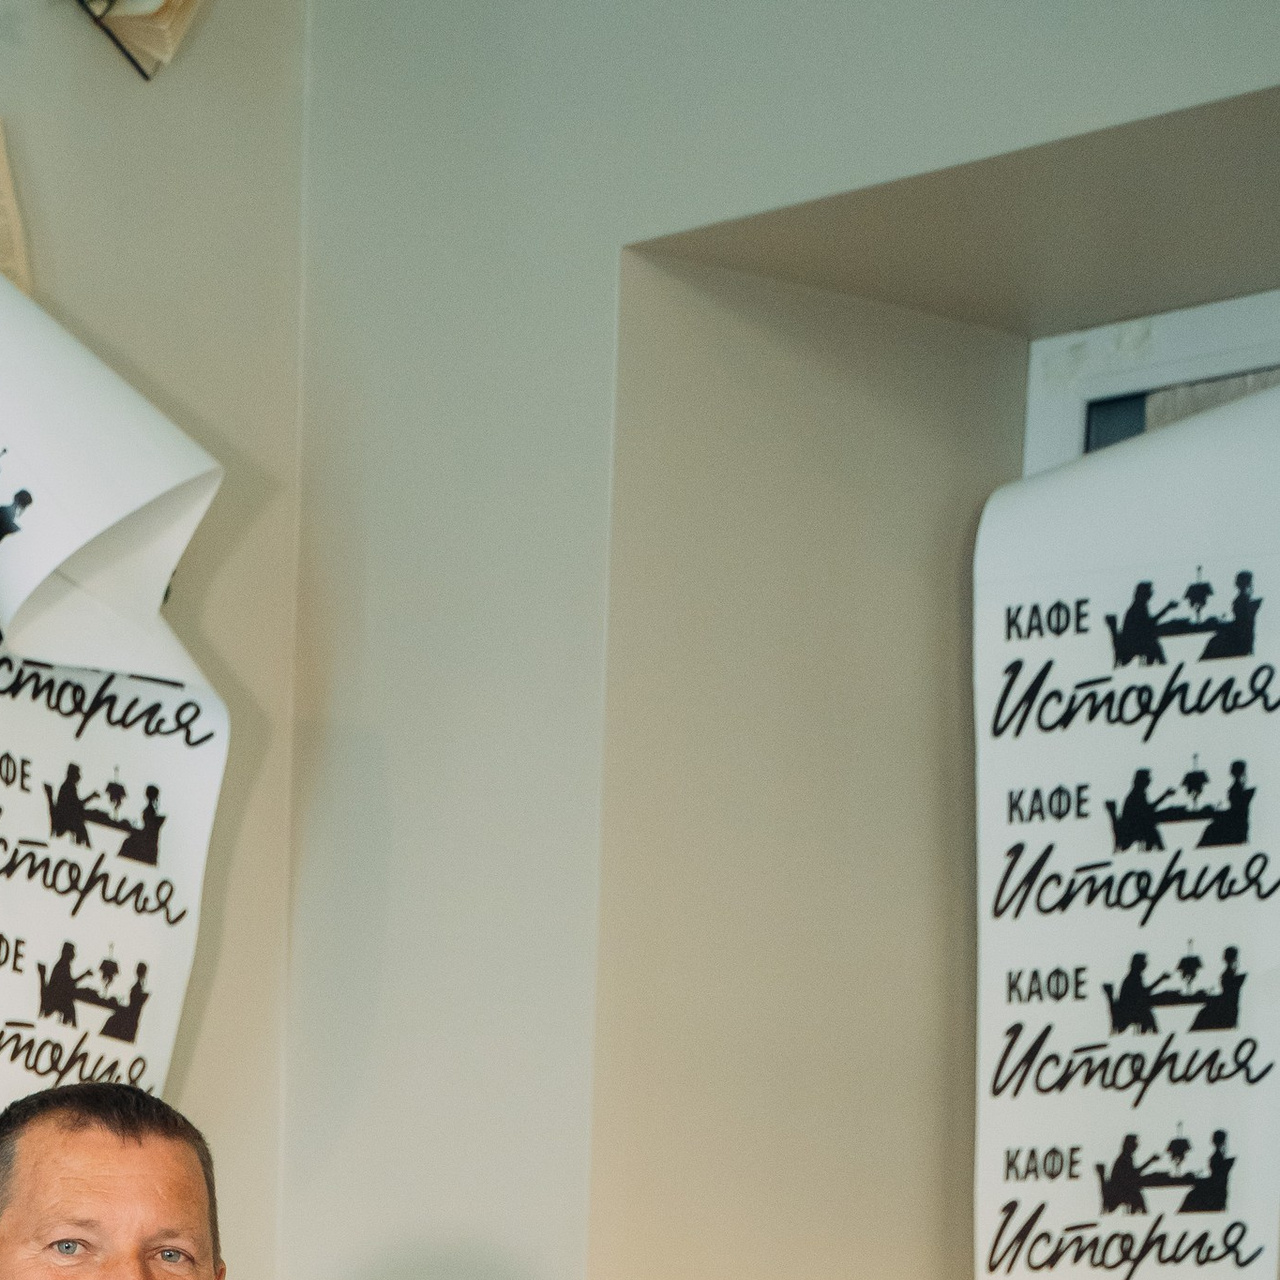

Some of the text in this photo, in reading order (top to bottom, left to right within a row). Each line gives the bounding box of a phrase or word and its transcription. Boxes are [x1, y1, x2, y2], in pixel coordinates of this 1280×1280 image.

[1005, 597, 1090, 642] КАФЕ
[991, 659, 1280, 744] История
[1008, 783, 1090, 824] КАФЕ
[992, 842, 1280, 928] История
[1006, 965, 1088, 1004] КАФЕ
[991, 1021, 1274, 1109] История
[1004, 1145, 1082, 1181] КАФЕ
